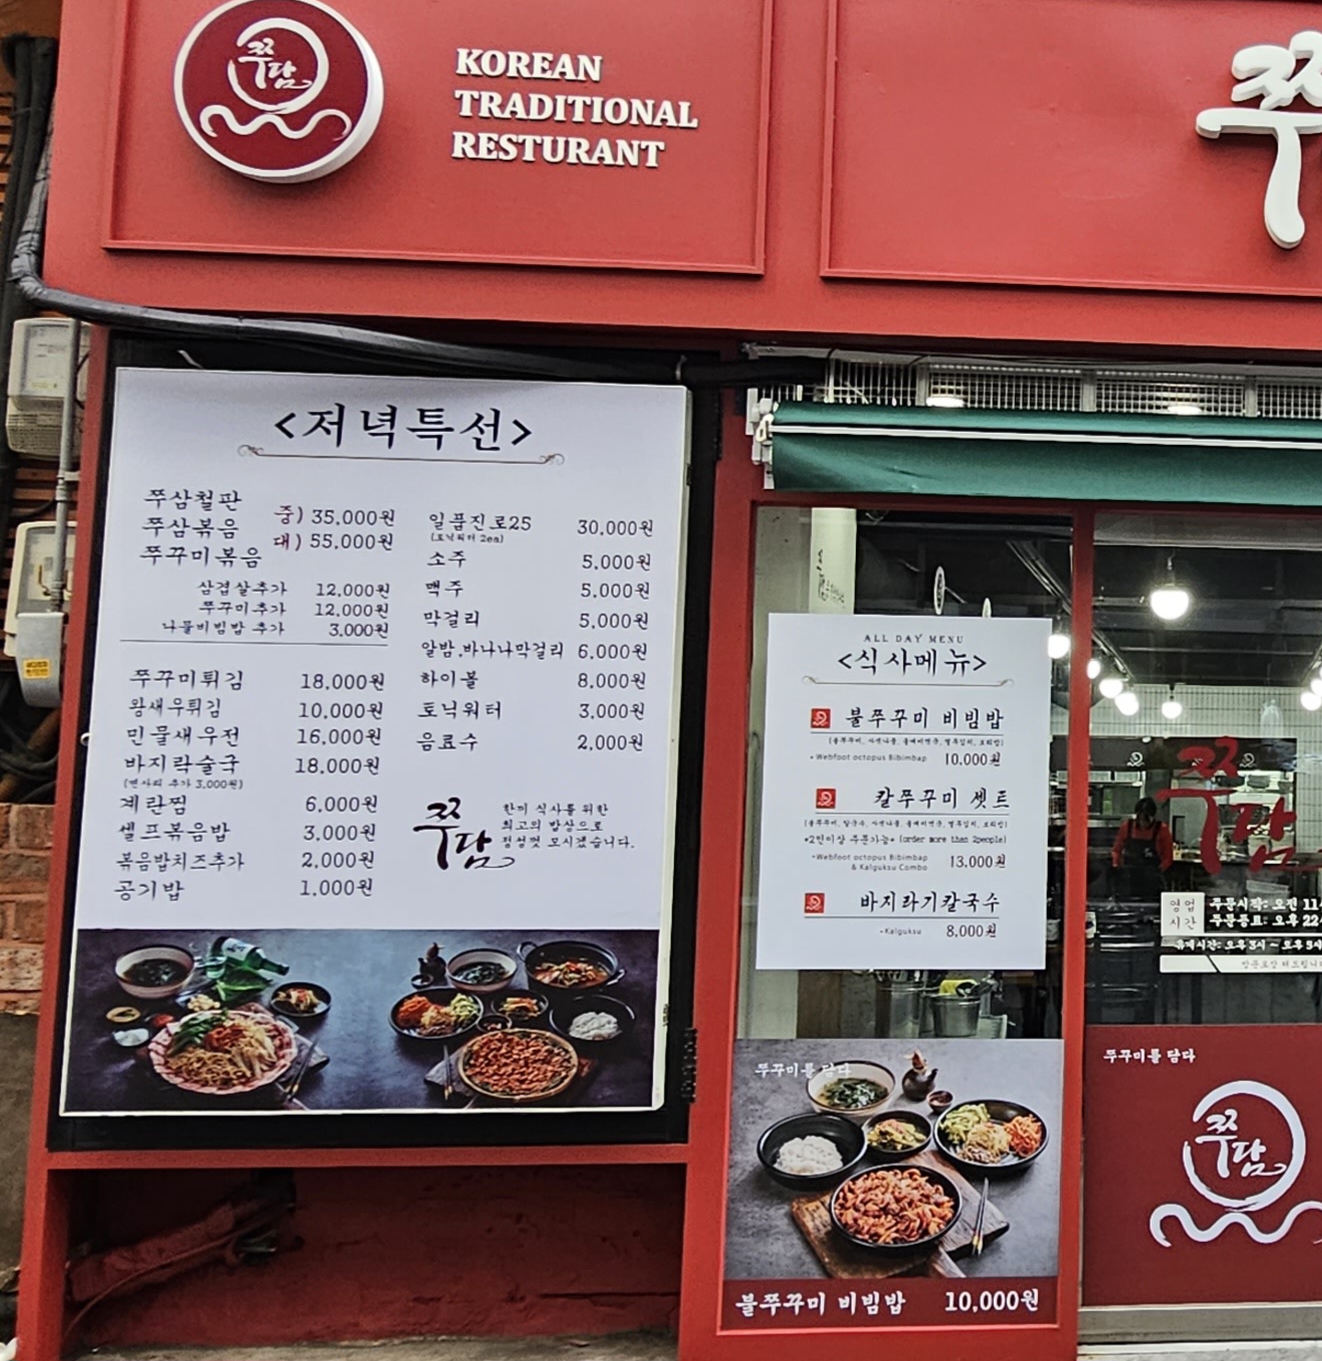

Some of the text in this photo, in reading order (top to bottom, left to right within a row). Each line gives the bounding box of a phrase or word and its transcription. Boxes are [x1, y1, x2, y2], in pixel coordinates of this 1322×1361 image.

[455, 48, 602, 82] KOREAN
[454, 89, 698, 129] TRADITIONAL
[451, 132, 664, 169] RESTURANT
[144, 489, 242, 511] 쭈삼철판
[142, 517, 239, 539] 쭈삼볶음
[429, 512, 532, 531] 일품진로25
[140, 545, 262, 568] 쭈꾸미볶음
[427, 550, 466, 568] 소주
[425, 580, 463, 598] 맥주
[424, 610, 480, 628] 막걸리
[864, 634, 964, 644] ALL DAY MENU
[130, 669, 243, 691] 쭈꾸미튀김
[420, 670, 478, 689] 하이볼
[129, 697, 221, 718] 왕새우튀김
[418, 700, 501, 720] 토닉워터
[845, 707, 1004, 730] 불쭈꾸미 비빔밥
[127, 725, 239, 747] 민물새우전
[416, 732, 478, 751] 음료수
[124, 754, 239, 775] 바지락술국
[853, 754, 886, 763] octopus
[120, 794, 187, 816] 계란찜
[536, 802, 576, 816] 식사를
[582, 803, 608, 816] 위한
[873, 787, 1010, 810] 칼쭈꾸미 셋트
[118, 822, 231, 843] 셀프볶음밥
[116, 851, 245, 873] 볶음밥치즈추가
[899, 863, 928, 871] Combo
[114, 880, 184, 902] 공기밥
[861, 891, 1000, 913] 바지라기칼국수
[1271, 897, 1298, 911] 오전
[1271, 913, 1299, 927] 오후
[1224, 939, 1247, 950] 오후
[1281, 939, 1304, 950] 오후
[1103, 1047, 1196, 1065] 쭈꾸미를 담다
[735, 1291, 827, 1318] 불쭈꾸미
[837, 1290, 907, 1317] 비빔밥
